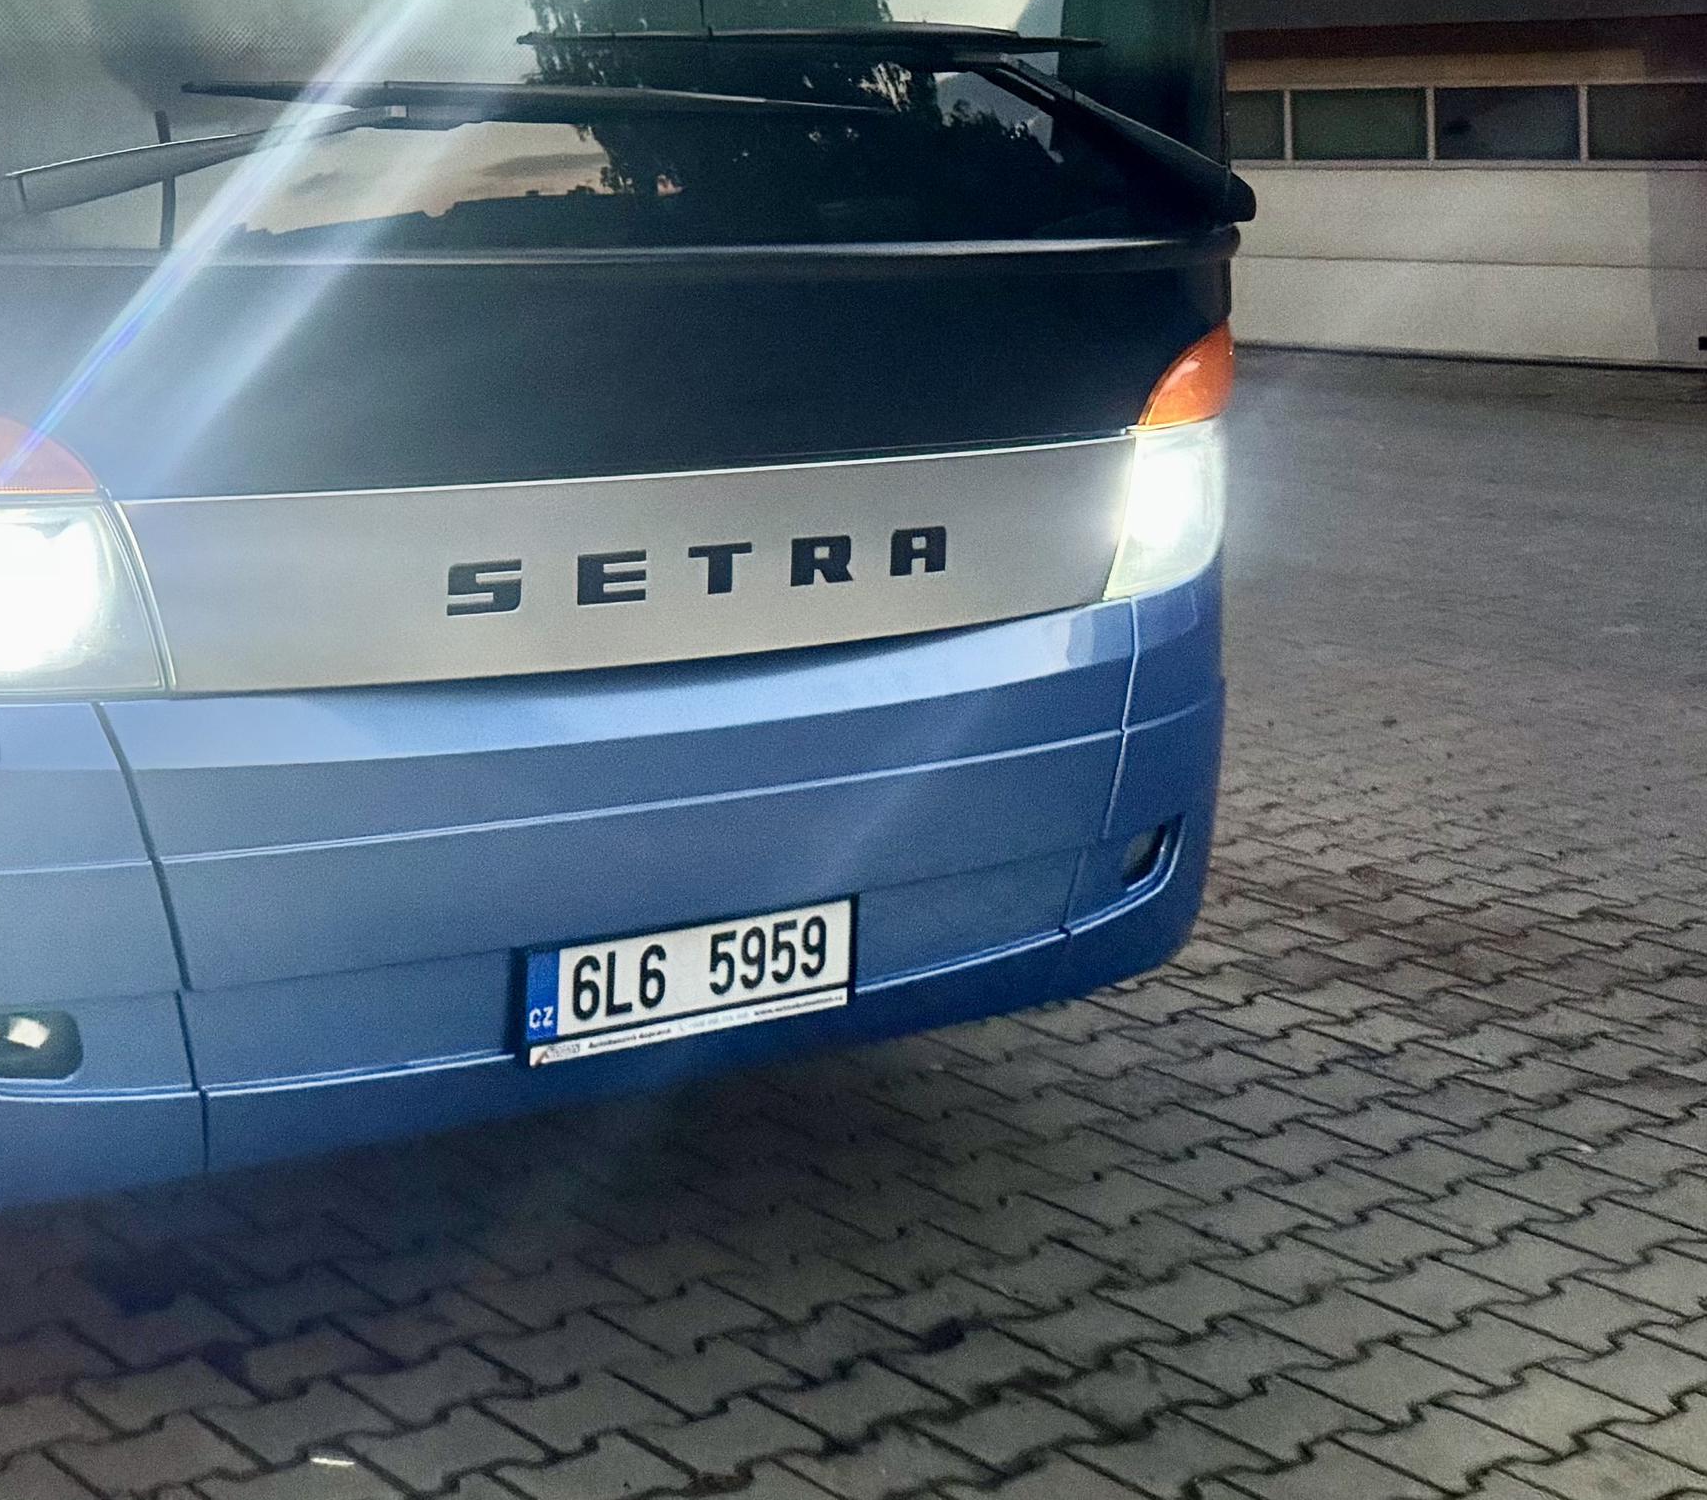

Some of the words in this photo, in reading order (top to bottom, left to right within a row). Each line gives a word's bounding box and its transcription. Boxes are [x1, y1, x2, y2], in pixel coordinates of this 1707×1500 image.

[446, 525, 948, 617] SETRA
[572, 943, 667, 1022] 6L6
[708, 914, 828, 997] 5959
[528, 1005, 554, 1029] CZ
